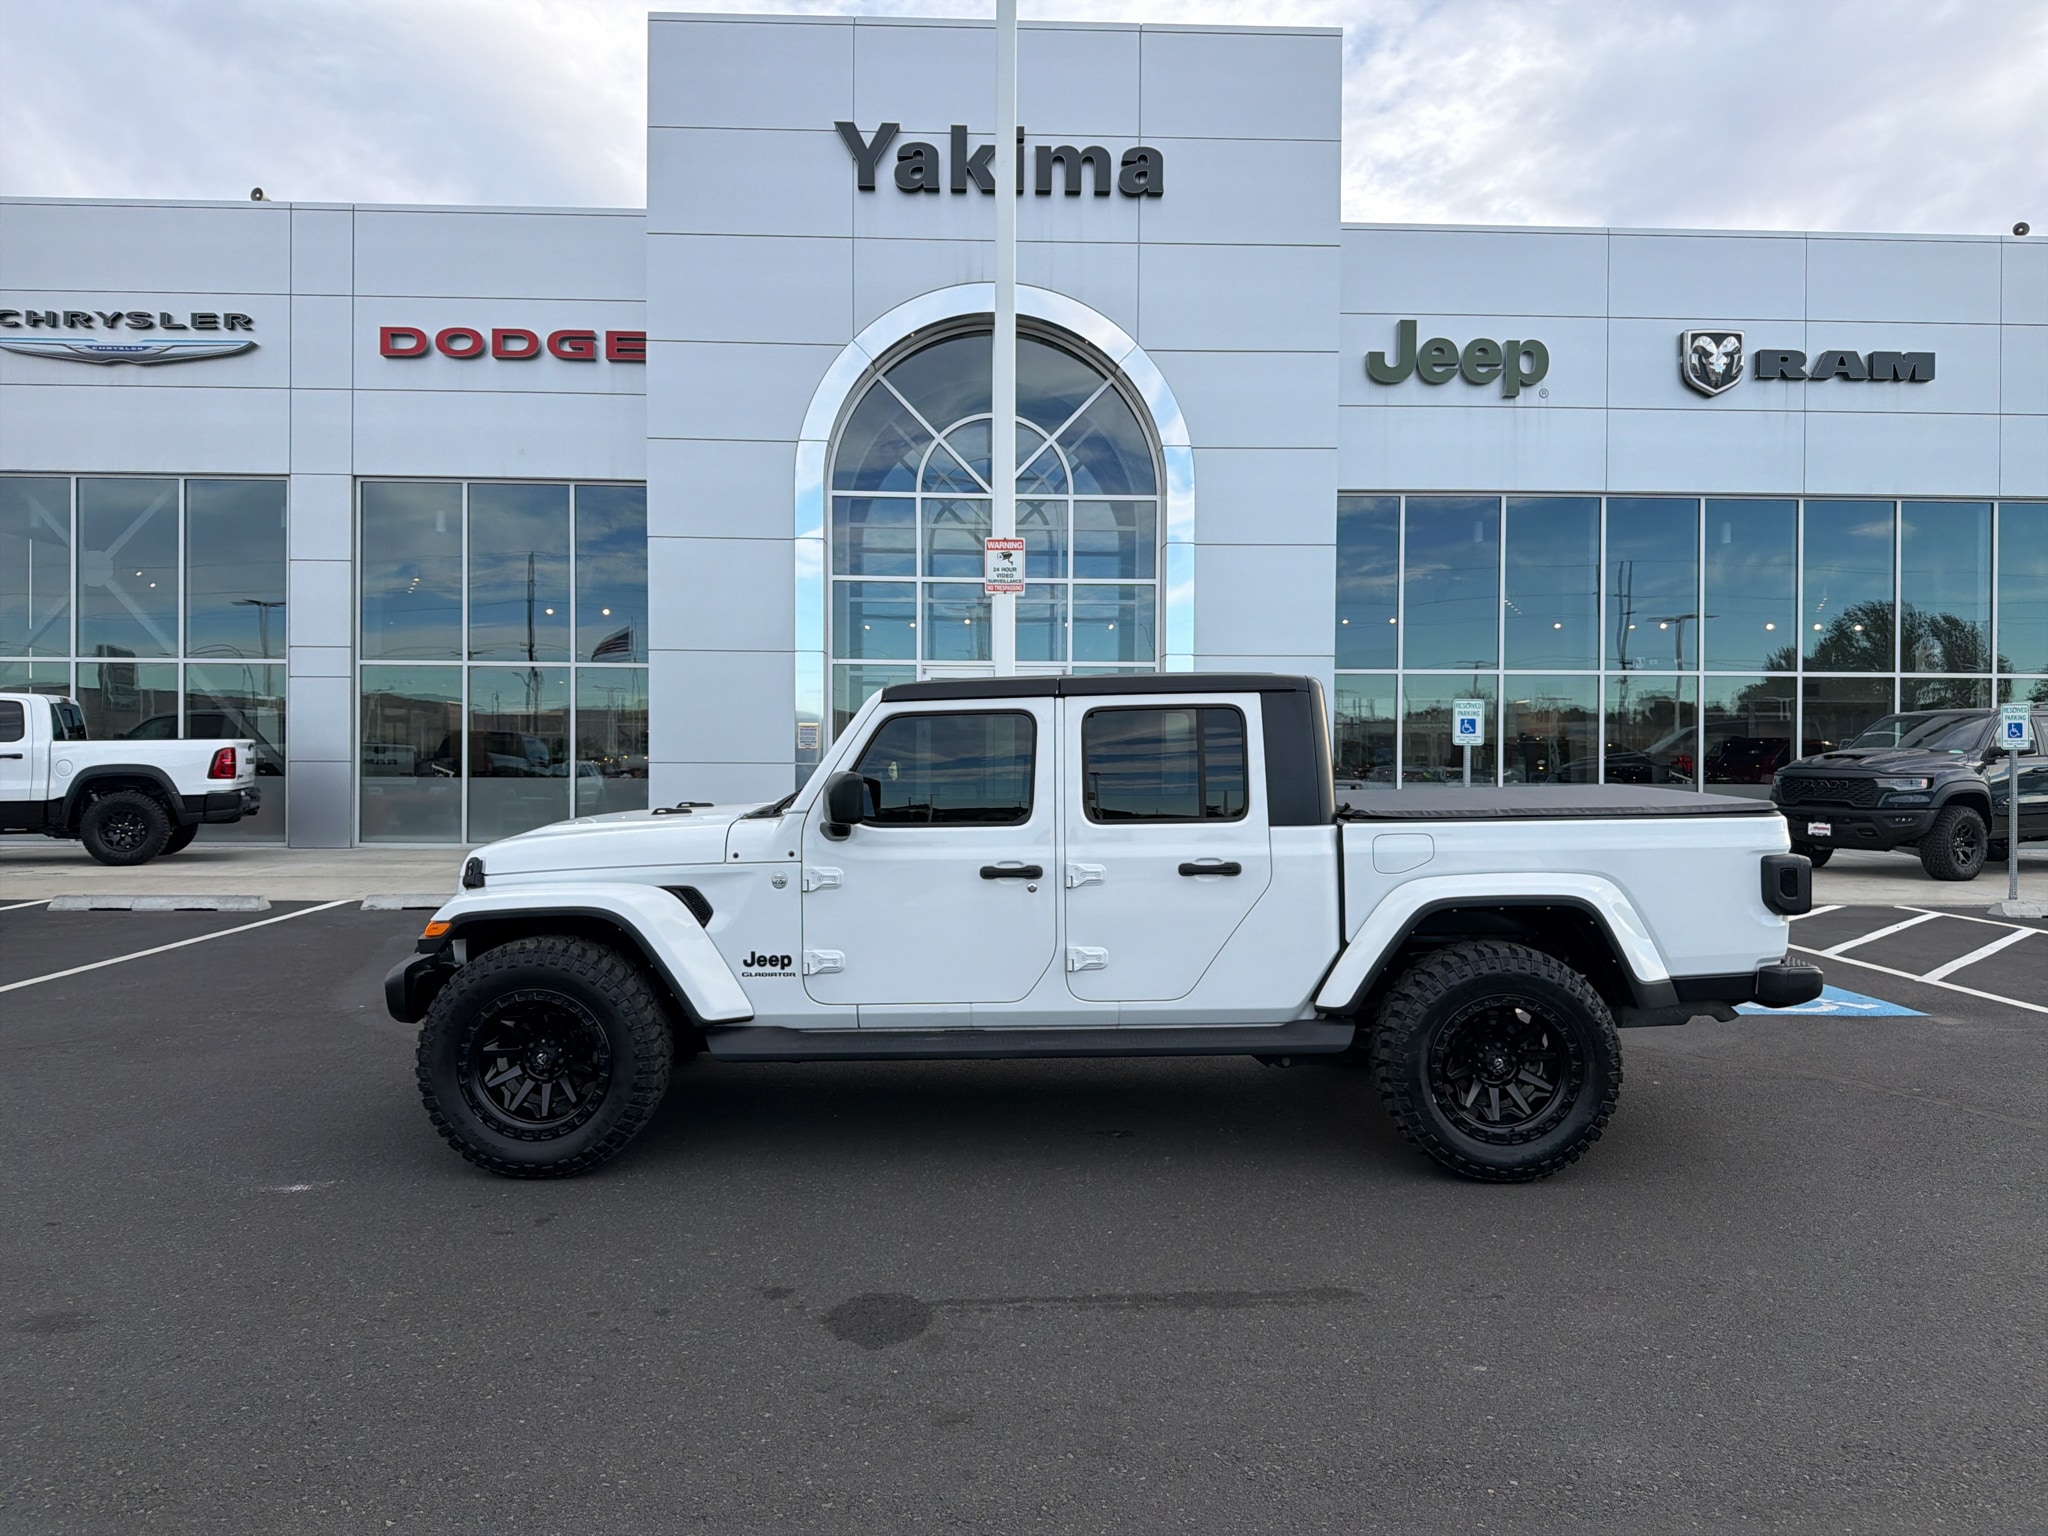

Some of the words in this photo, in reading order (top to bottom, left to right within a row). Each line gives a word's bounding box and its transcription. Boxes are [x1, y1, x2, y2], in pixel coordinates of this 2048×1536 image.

[0, 309, 252, 330] CHRYSLER
[379, 326, 646, 361] DODGE
[1366, 319, 1550, 398] Jeep
[1755, 349, 1936, 382] RAM
[987, 541, 1023, 549] WARNING
[743, 951, 792, 970] Jeep
